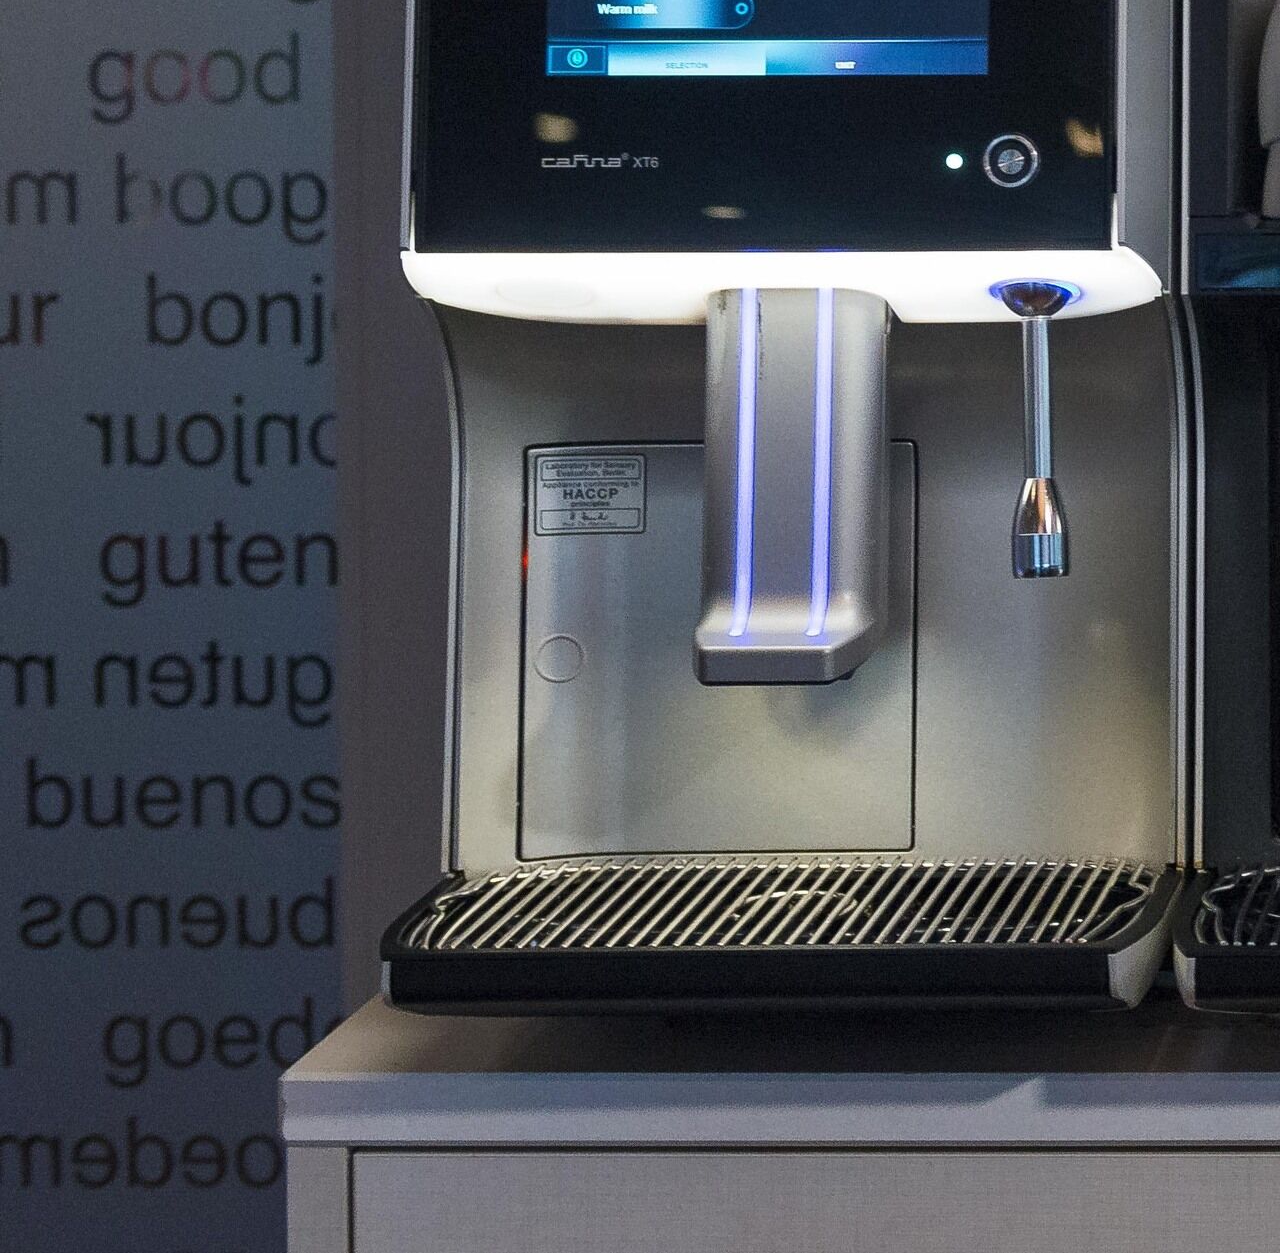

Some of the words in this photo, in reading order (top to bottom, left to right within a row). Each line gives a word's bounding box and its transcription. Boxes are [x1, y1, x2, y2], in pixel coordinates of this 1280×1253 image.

[597, 3, 631, 15] Warm
[633, 3, 658, 15] milk
[88, 32, 300, 124] good
[665, 62, 708, 70] SELECTION
[633, 156, 660, 168] XT6
[563, 488, 618, 499] HACCP
[101, 520, 340, 608] guten
[26, 757, 342, 830] buenos
[103, 996, 340, 1089] goed
